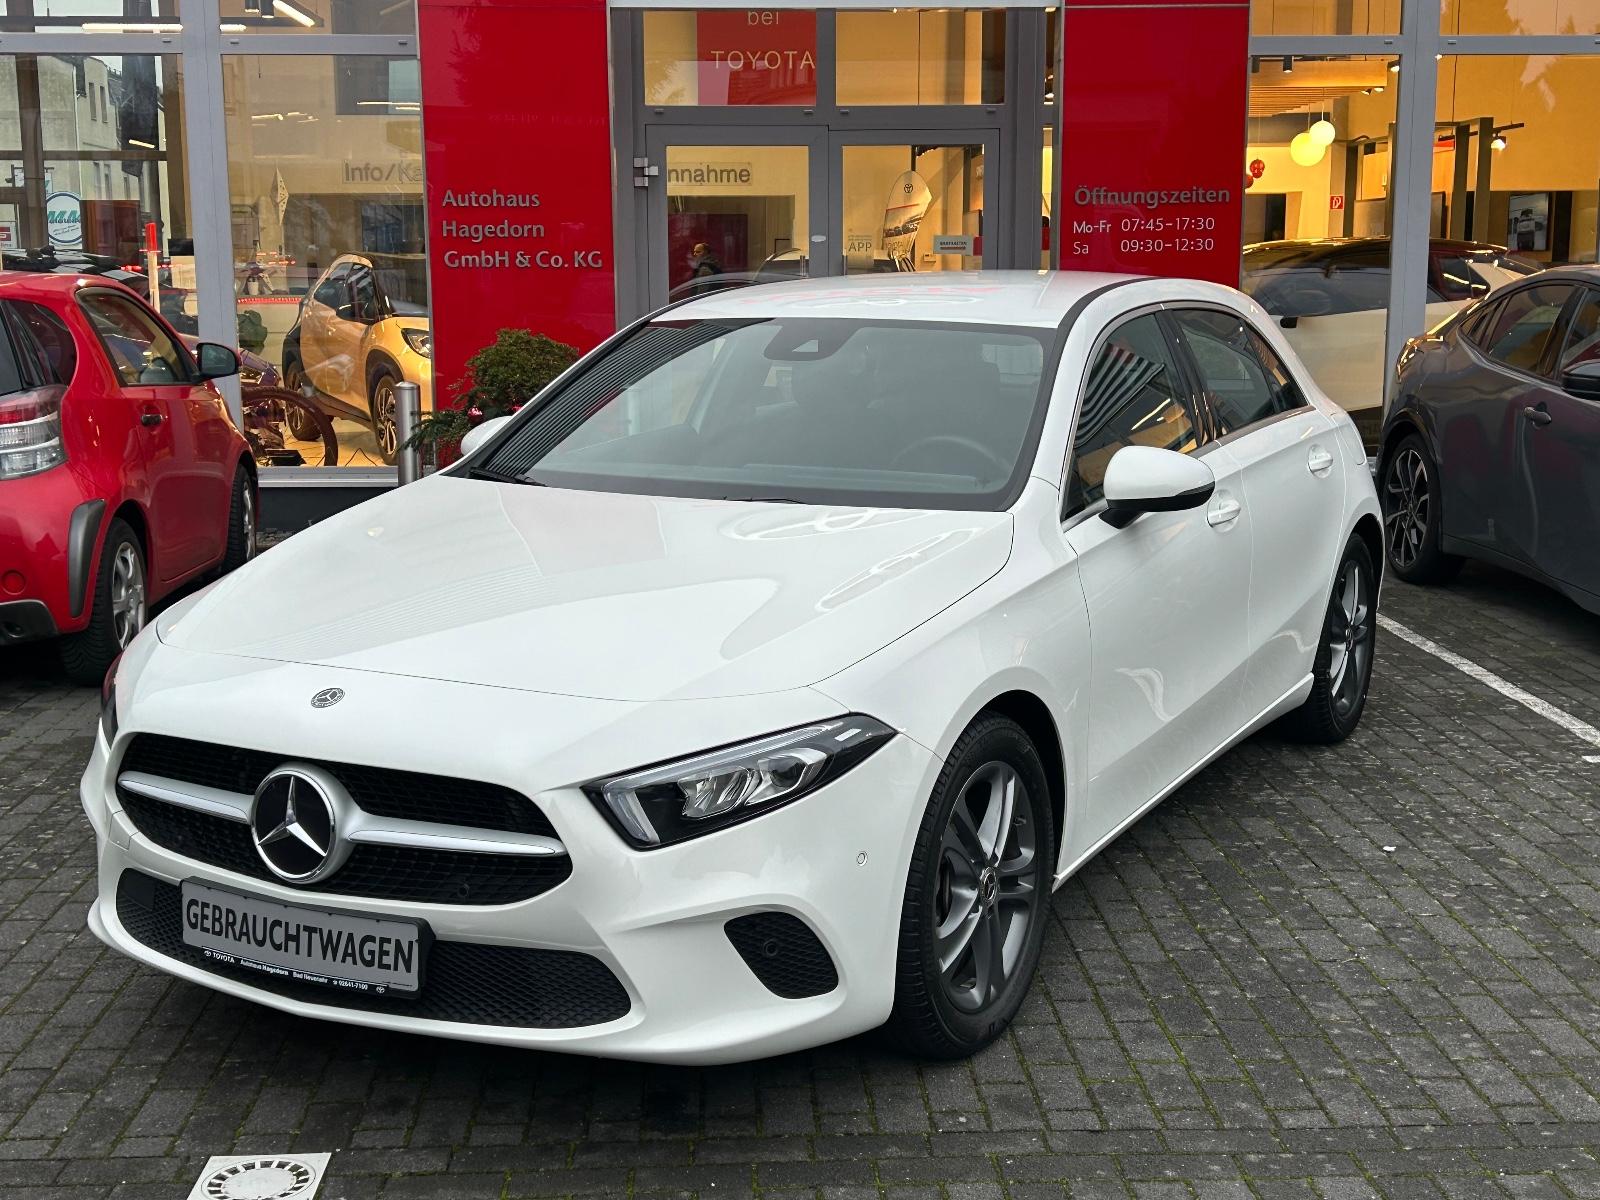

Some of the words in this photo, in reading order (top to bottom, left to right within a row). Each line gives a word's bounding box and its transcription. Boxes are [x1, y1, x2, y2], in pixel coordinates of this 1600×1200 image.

[711, 50, 816, 70] TOYOTA
[667, 164, 751, 183] nnahme
[442, 189, 541, 208] Autohaus
[1074, 184, 1231, 209] Öffnungszeiten
[442, 219, 545, 243] Hagedorn
[1073, 220, 1112, 234] Mo-Fr
[1121, 217, 1216, 232] 07:45-17:30
[848, 241, 873, 252] APP
[1073, 241, 1089, 255] Sa
[1120, 238, 1214, 252] 09:30-12:30
[444, 250, 510, 268] GmbH
[515, 250, 532, 268] &
[536, 250, 569, 268] Co.
[574, 250, 603, 268] KG
[186, 898, 414, 974] GEBRAUCHTWAGEN
[213, 952, 235, 963] TOYOTA
